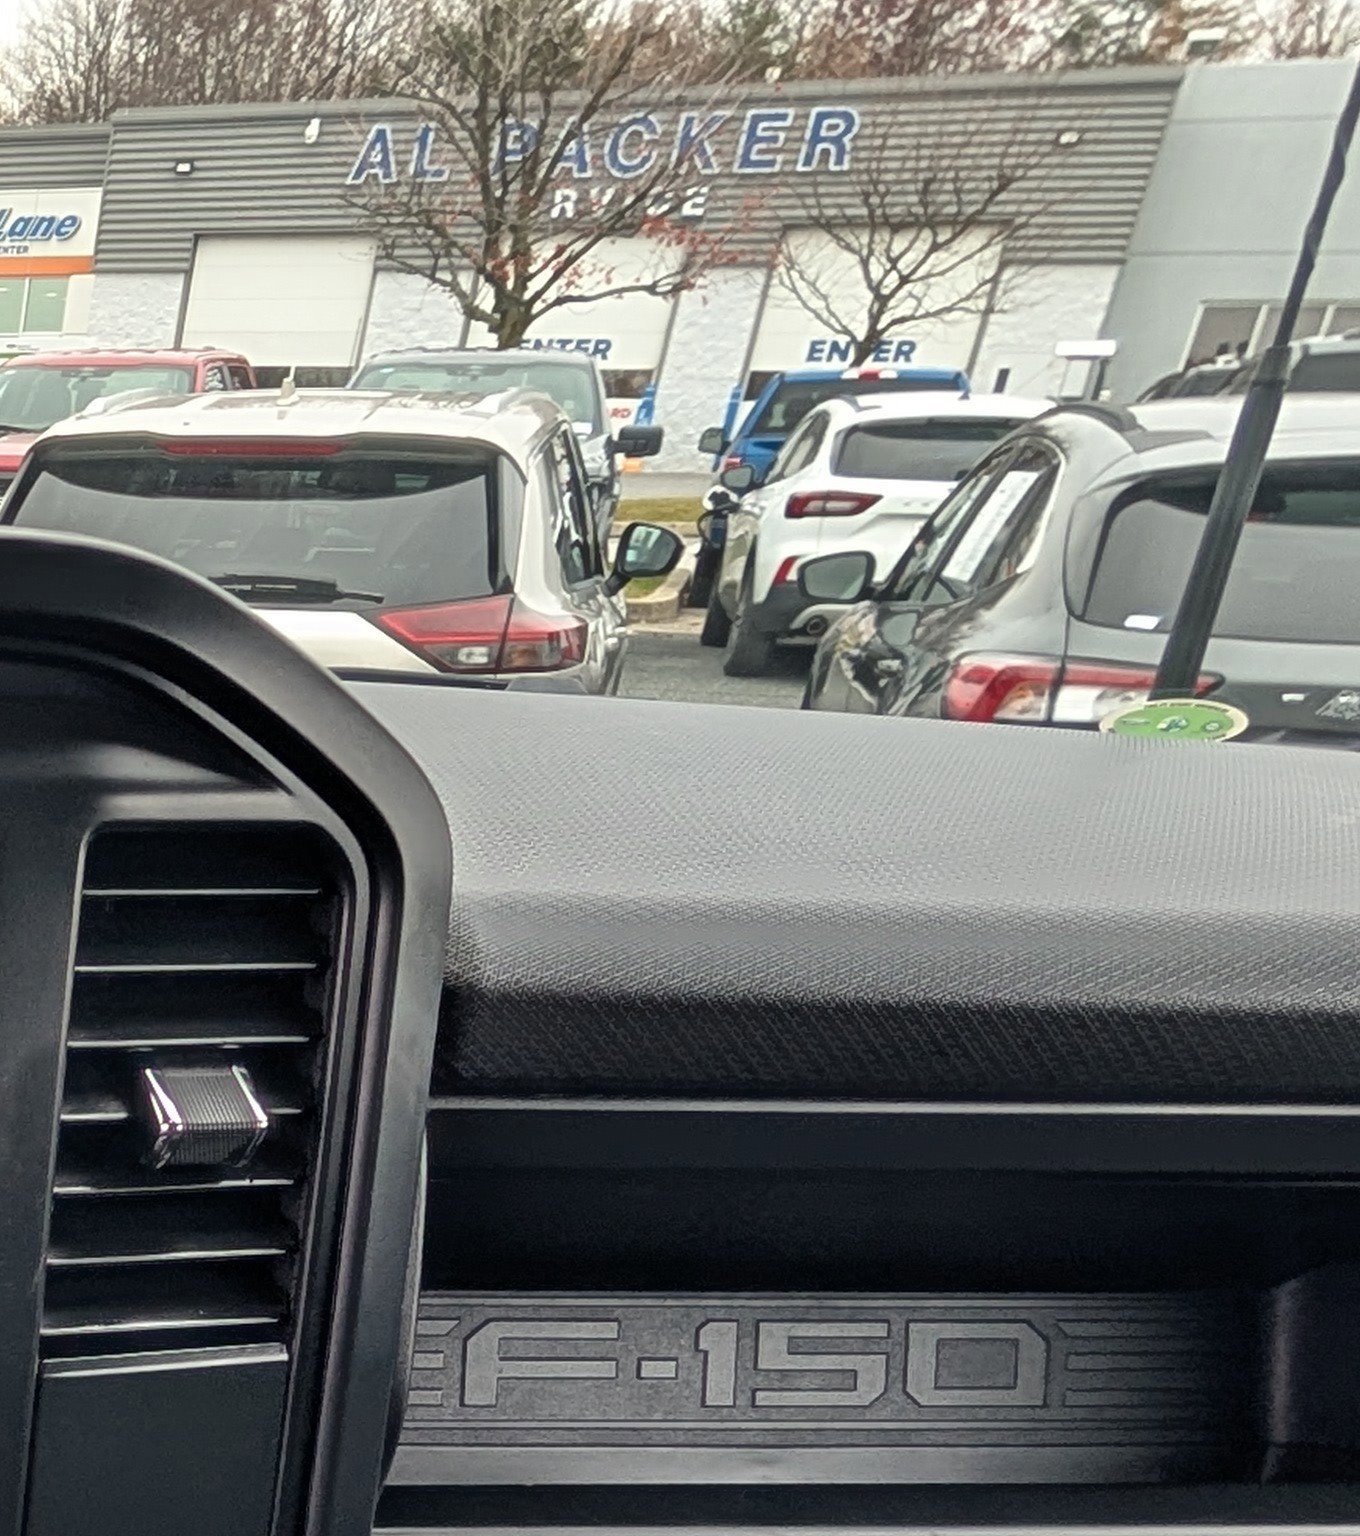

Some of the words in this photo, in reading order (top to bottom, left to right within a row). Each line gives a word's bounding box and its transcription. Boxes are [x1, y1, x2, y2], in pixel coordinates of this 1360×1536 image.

[345, 122, 450, 186] AL
[490, 106, 860, 180] PACKER
[805, 339, 918, 362] ENER
[461, 1318, 1051, 1408] F-150
